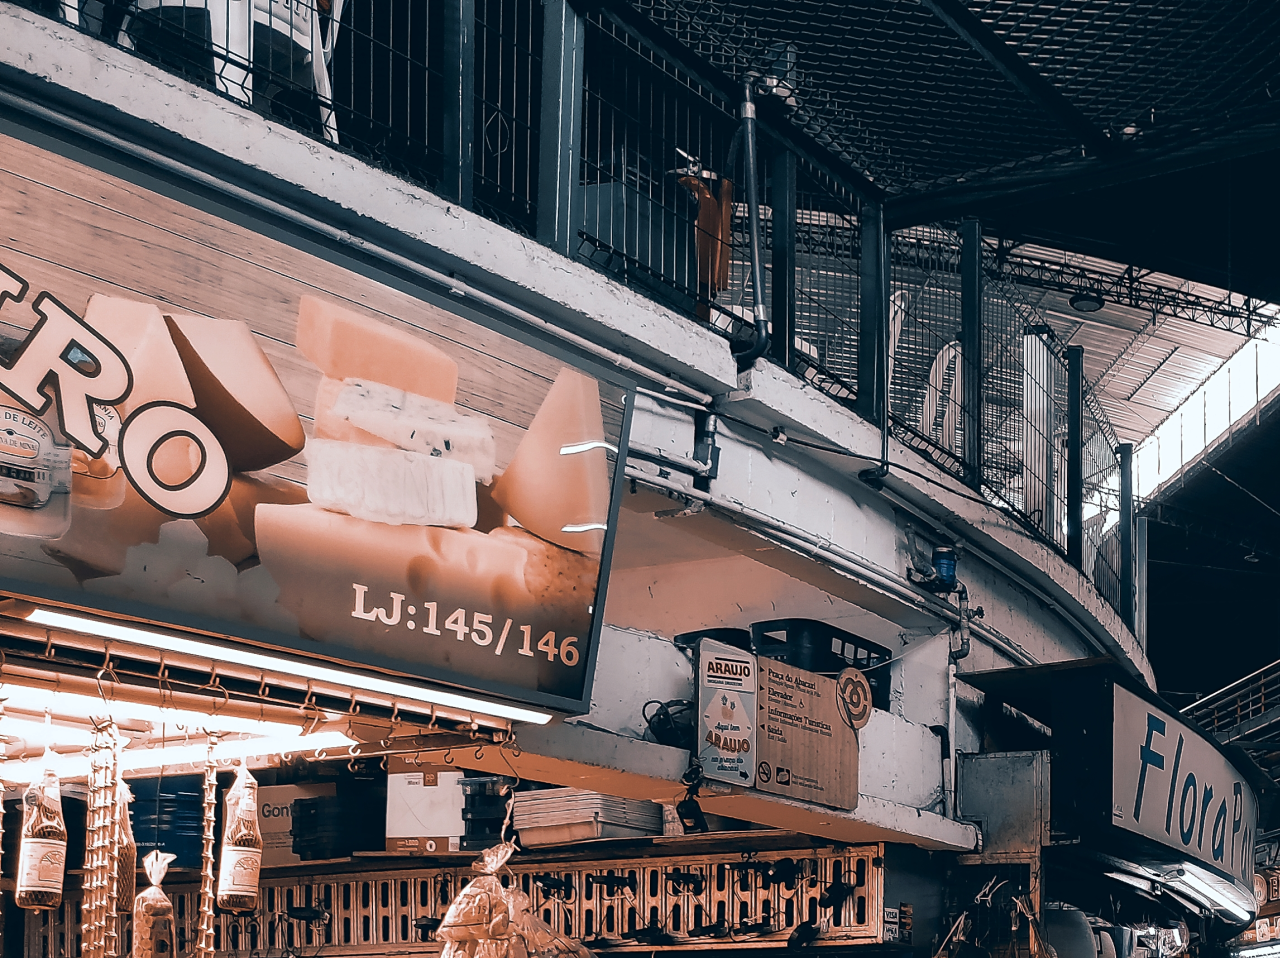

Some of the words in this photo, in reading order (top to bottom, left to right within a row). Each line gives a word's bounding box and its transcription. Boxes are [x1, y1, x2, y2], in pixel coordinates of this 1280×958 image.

[0, 262, 233, 519] RO
[351, 582, 580, 667] LJ:145/146
[707, 661, 750, 678] ARAUJO
[705, 730, 751, 753] ARAUJO
[1133, 711, 1228, 865] Flora
